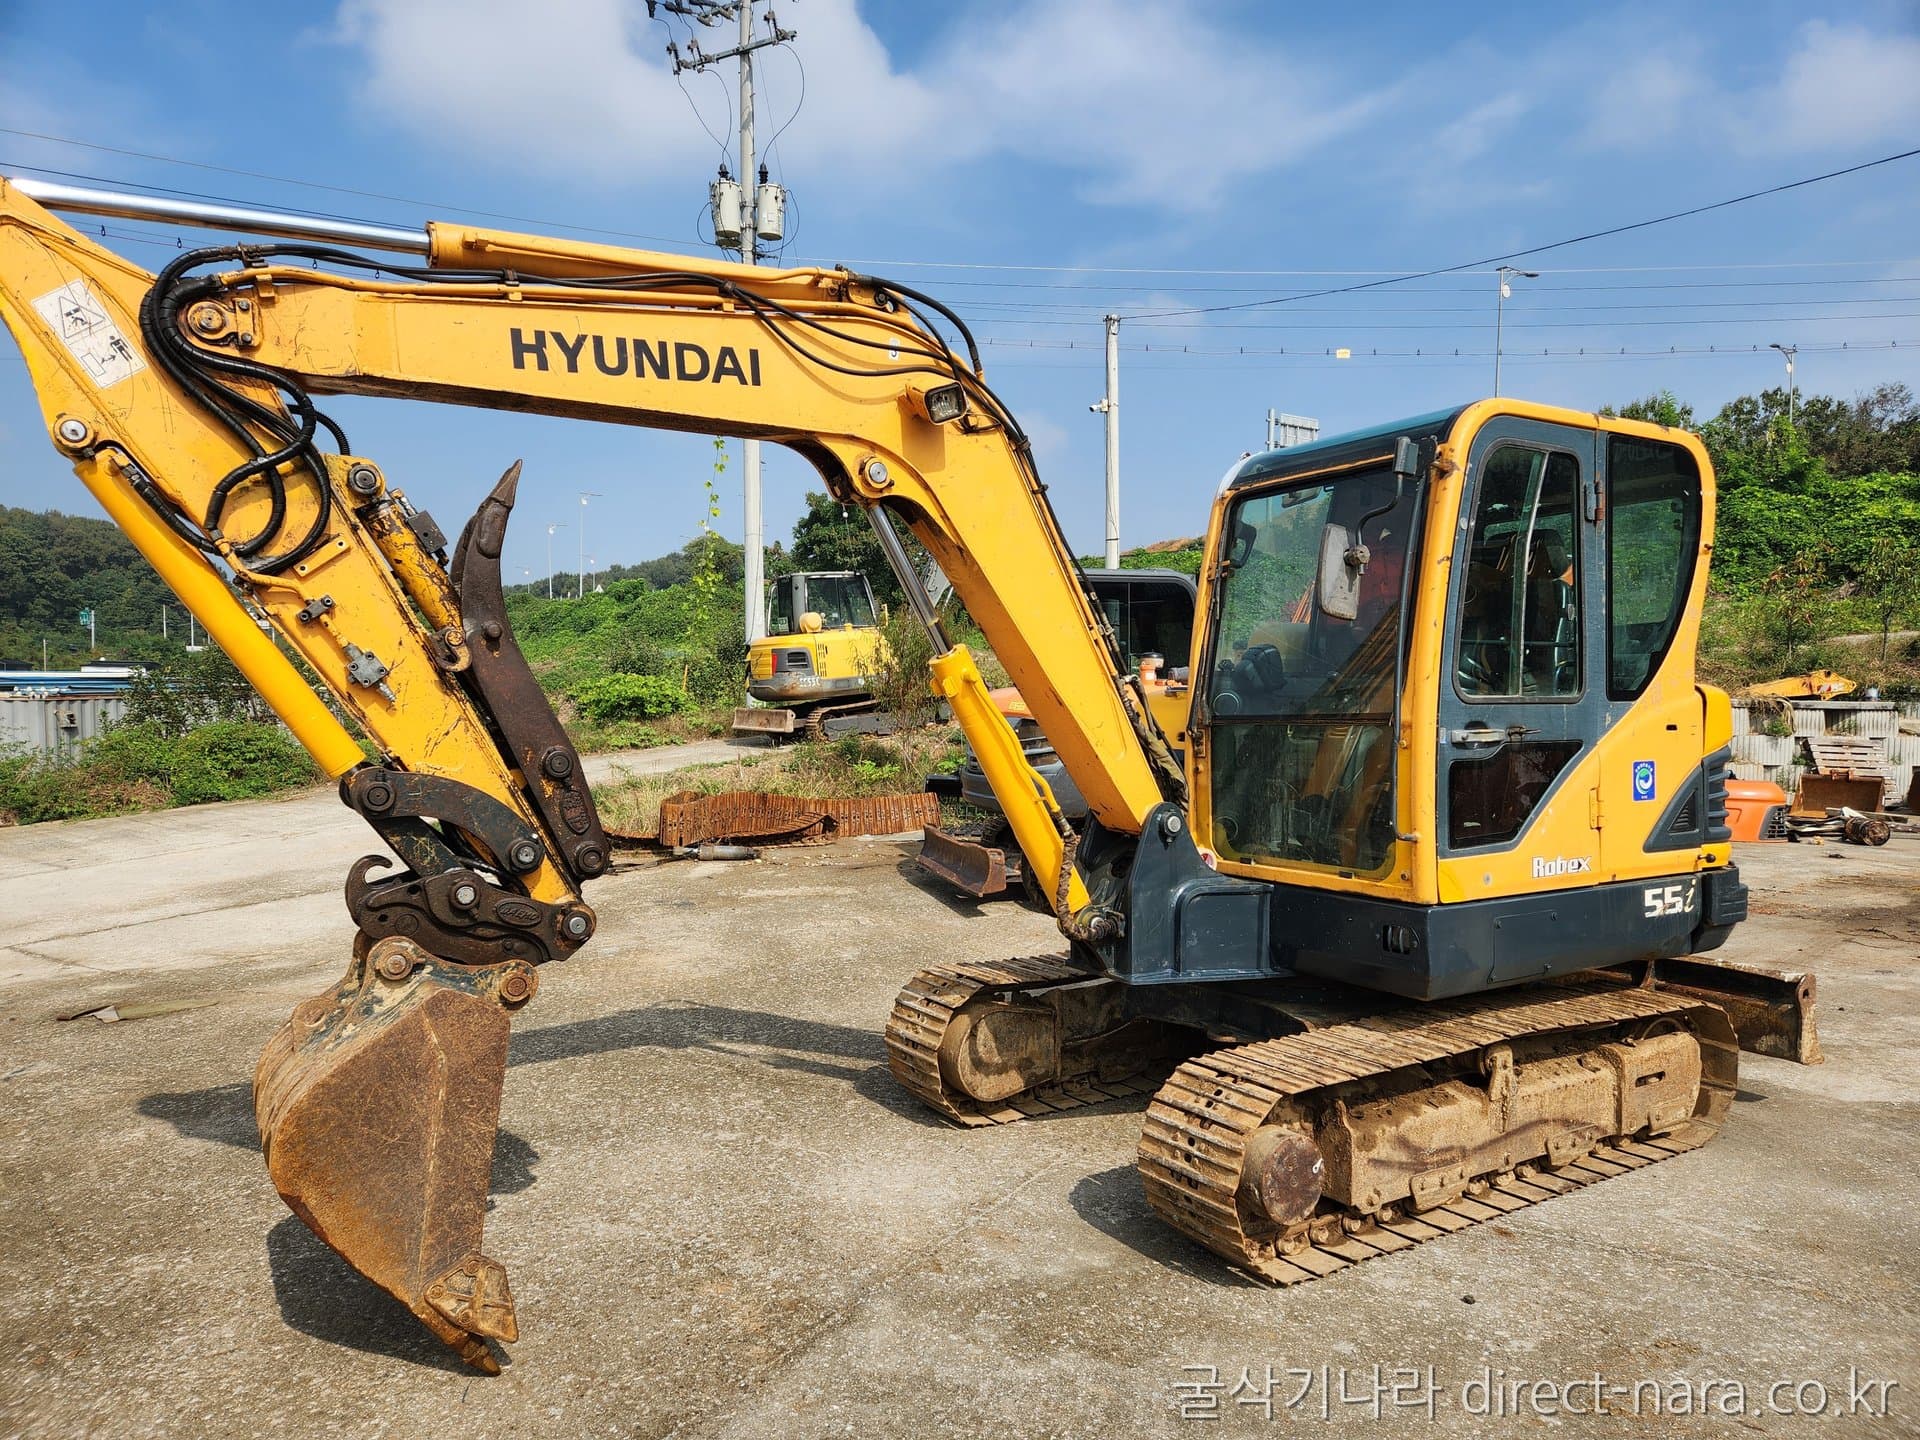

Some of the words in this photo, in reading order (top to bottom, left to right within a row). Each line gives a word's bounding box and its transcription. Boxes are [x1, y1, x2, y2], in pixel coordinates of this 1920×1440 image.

[510, 327, 762, 387] HYUNDAI
[1532, 855, 1592, 878] Robex
[1644, 878, 1697, 919] 55i
